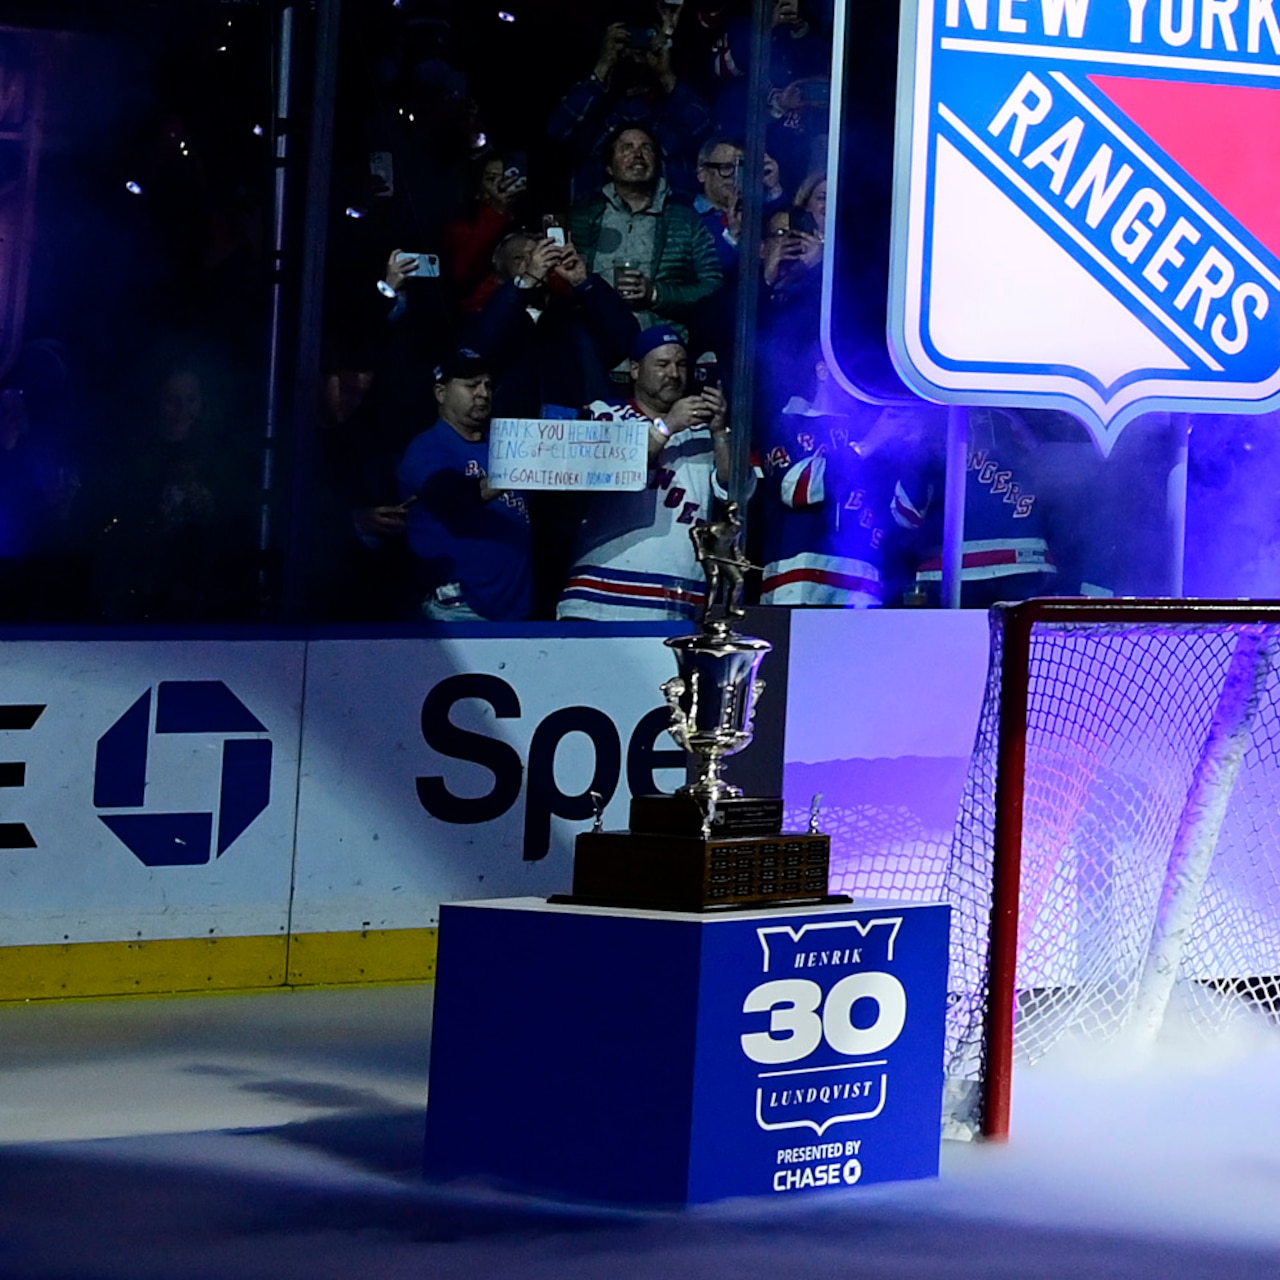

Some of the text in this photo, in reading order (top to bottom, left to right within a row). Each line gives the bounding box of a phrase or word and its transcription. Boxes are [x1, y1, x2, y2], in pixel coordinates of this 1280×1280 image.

[986, 70, 1270, 356] RANGERS
[537, 422, 564, 441] YOU
[613, 423, 646, 446] THE
[794, 948, 864, 969] HENRIK
[740, 970, 908, 1065] 30
[769, 1080, 874, 1108] LUNDQVIST
[776, 1140, 862, 1165] PRESENTED BY
[772, 1163, 842, 1192] CHASE
